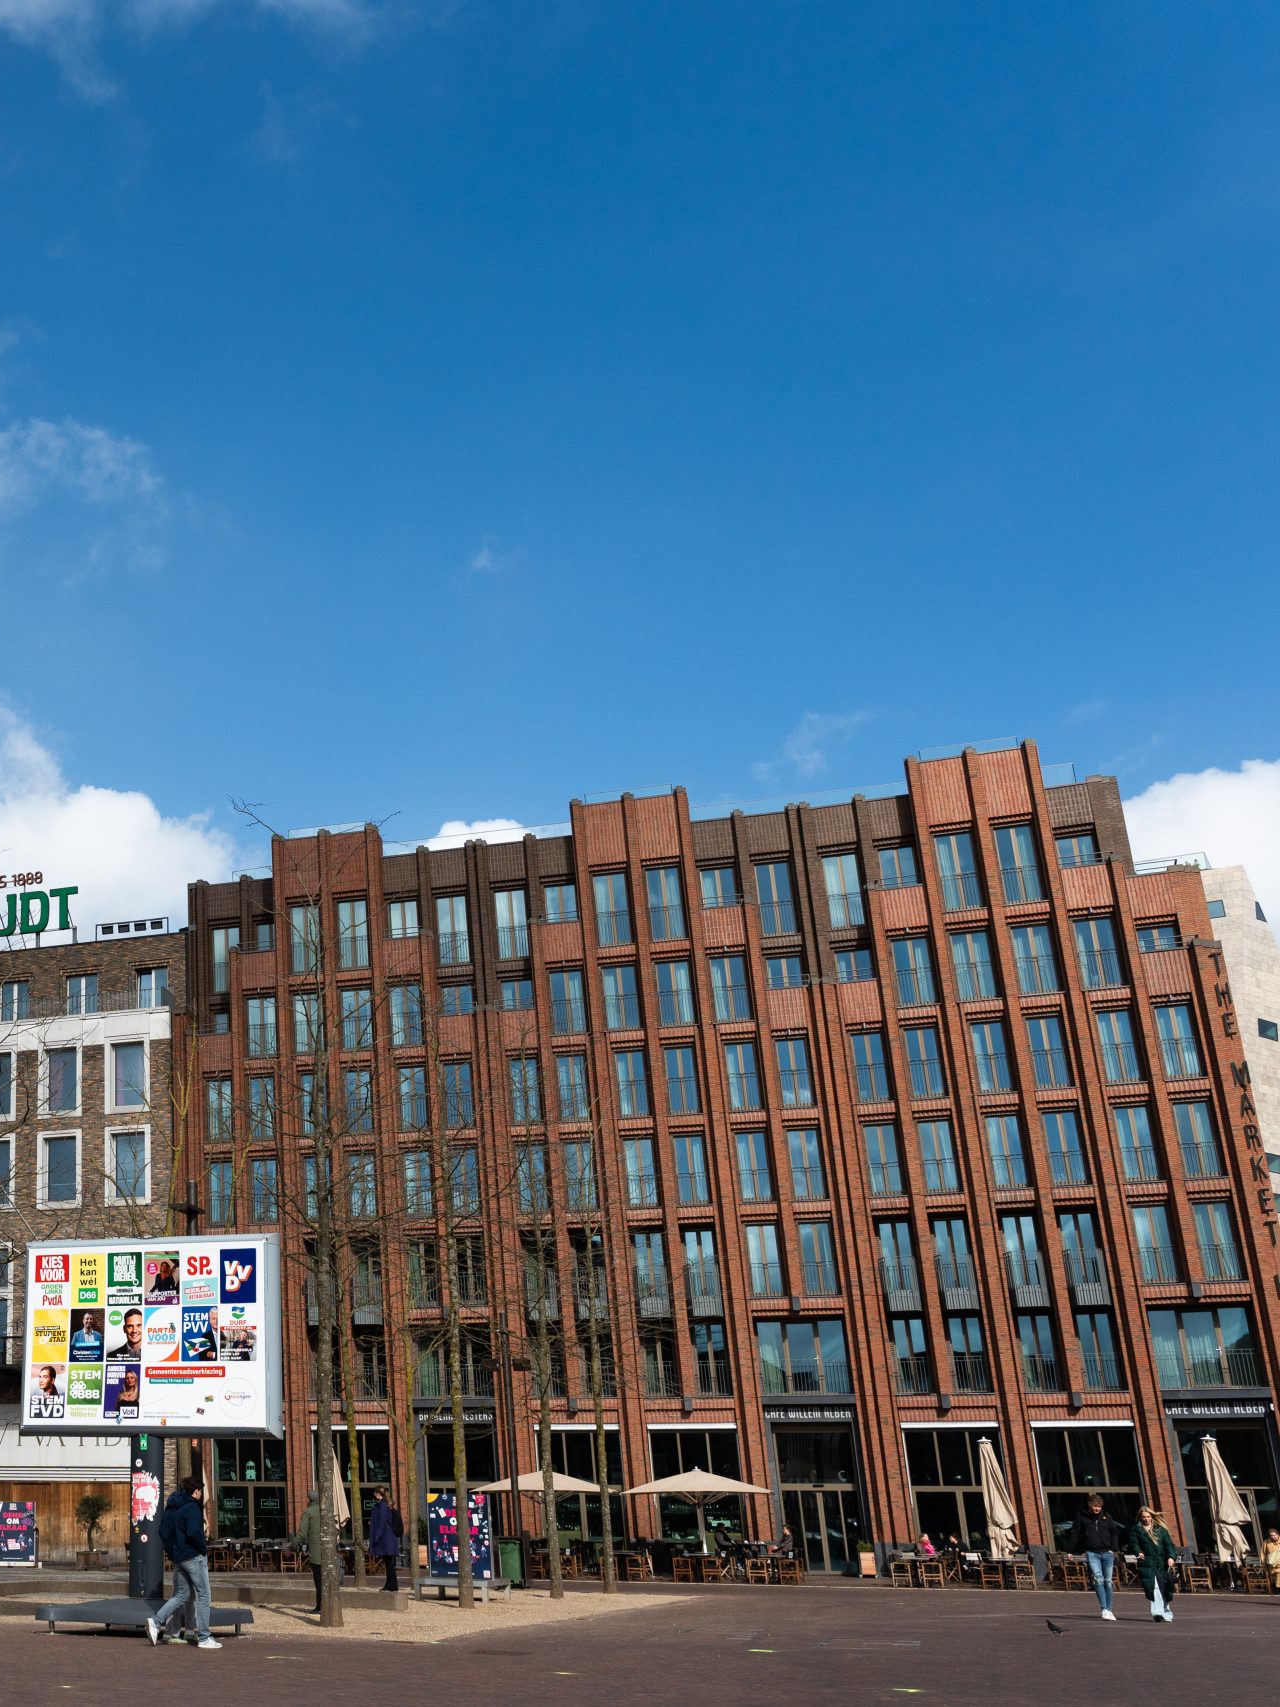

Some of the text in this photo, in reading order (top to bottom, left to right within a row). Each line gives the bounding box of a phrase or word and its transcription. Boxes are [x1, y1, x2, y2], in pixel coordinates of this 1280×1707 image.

[11, 871, 43, 887] 1888
[1208, 953, 1238, 1038] THE
[1230, 1060, 1278, 1248] MARKET
[42, 1256, 64, 1268] KIES
[80, 1258, 97, 1266] Het
[114, 1256, 136, 1265] PARTIJ
[40, 1268, 65, 1281] VOOR
[80, 1268, 97, 1276] kan
[80, 1277, 97, 1286] wél
[42, 1295, 63, 1306] PvdA
[184, 1313, 208, 1321] STEM
[184, 1321, 208, 1333] PVV
[70, 1370, 101, 1379] STEM
[148, 1368, 222, 1376] Gemeenteraadsverkiezing
[30, 1395, 63, 1404] STEM
[30, 1405, 64, 1417] FVD
[787, 1407, 821, 1419] WILLEM
[1192, 1402, 1230, 1414] WILLEM
